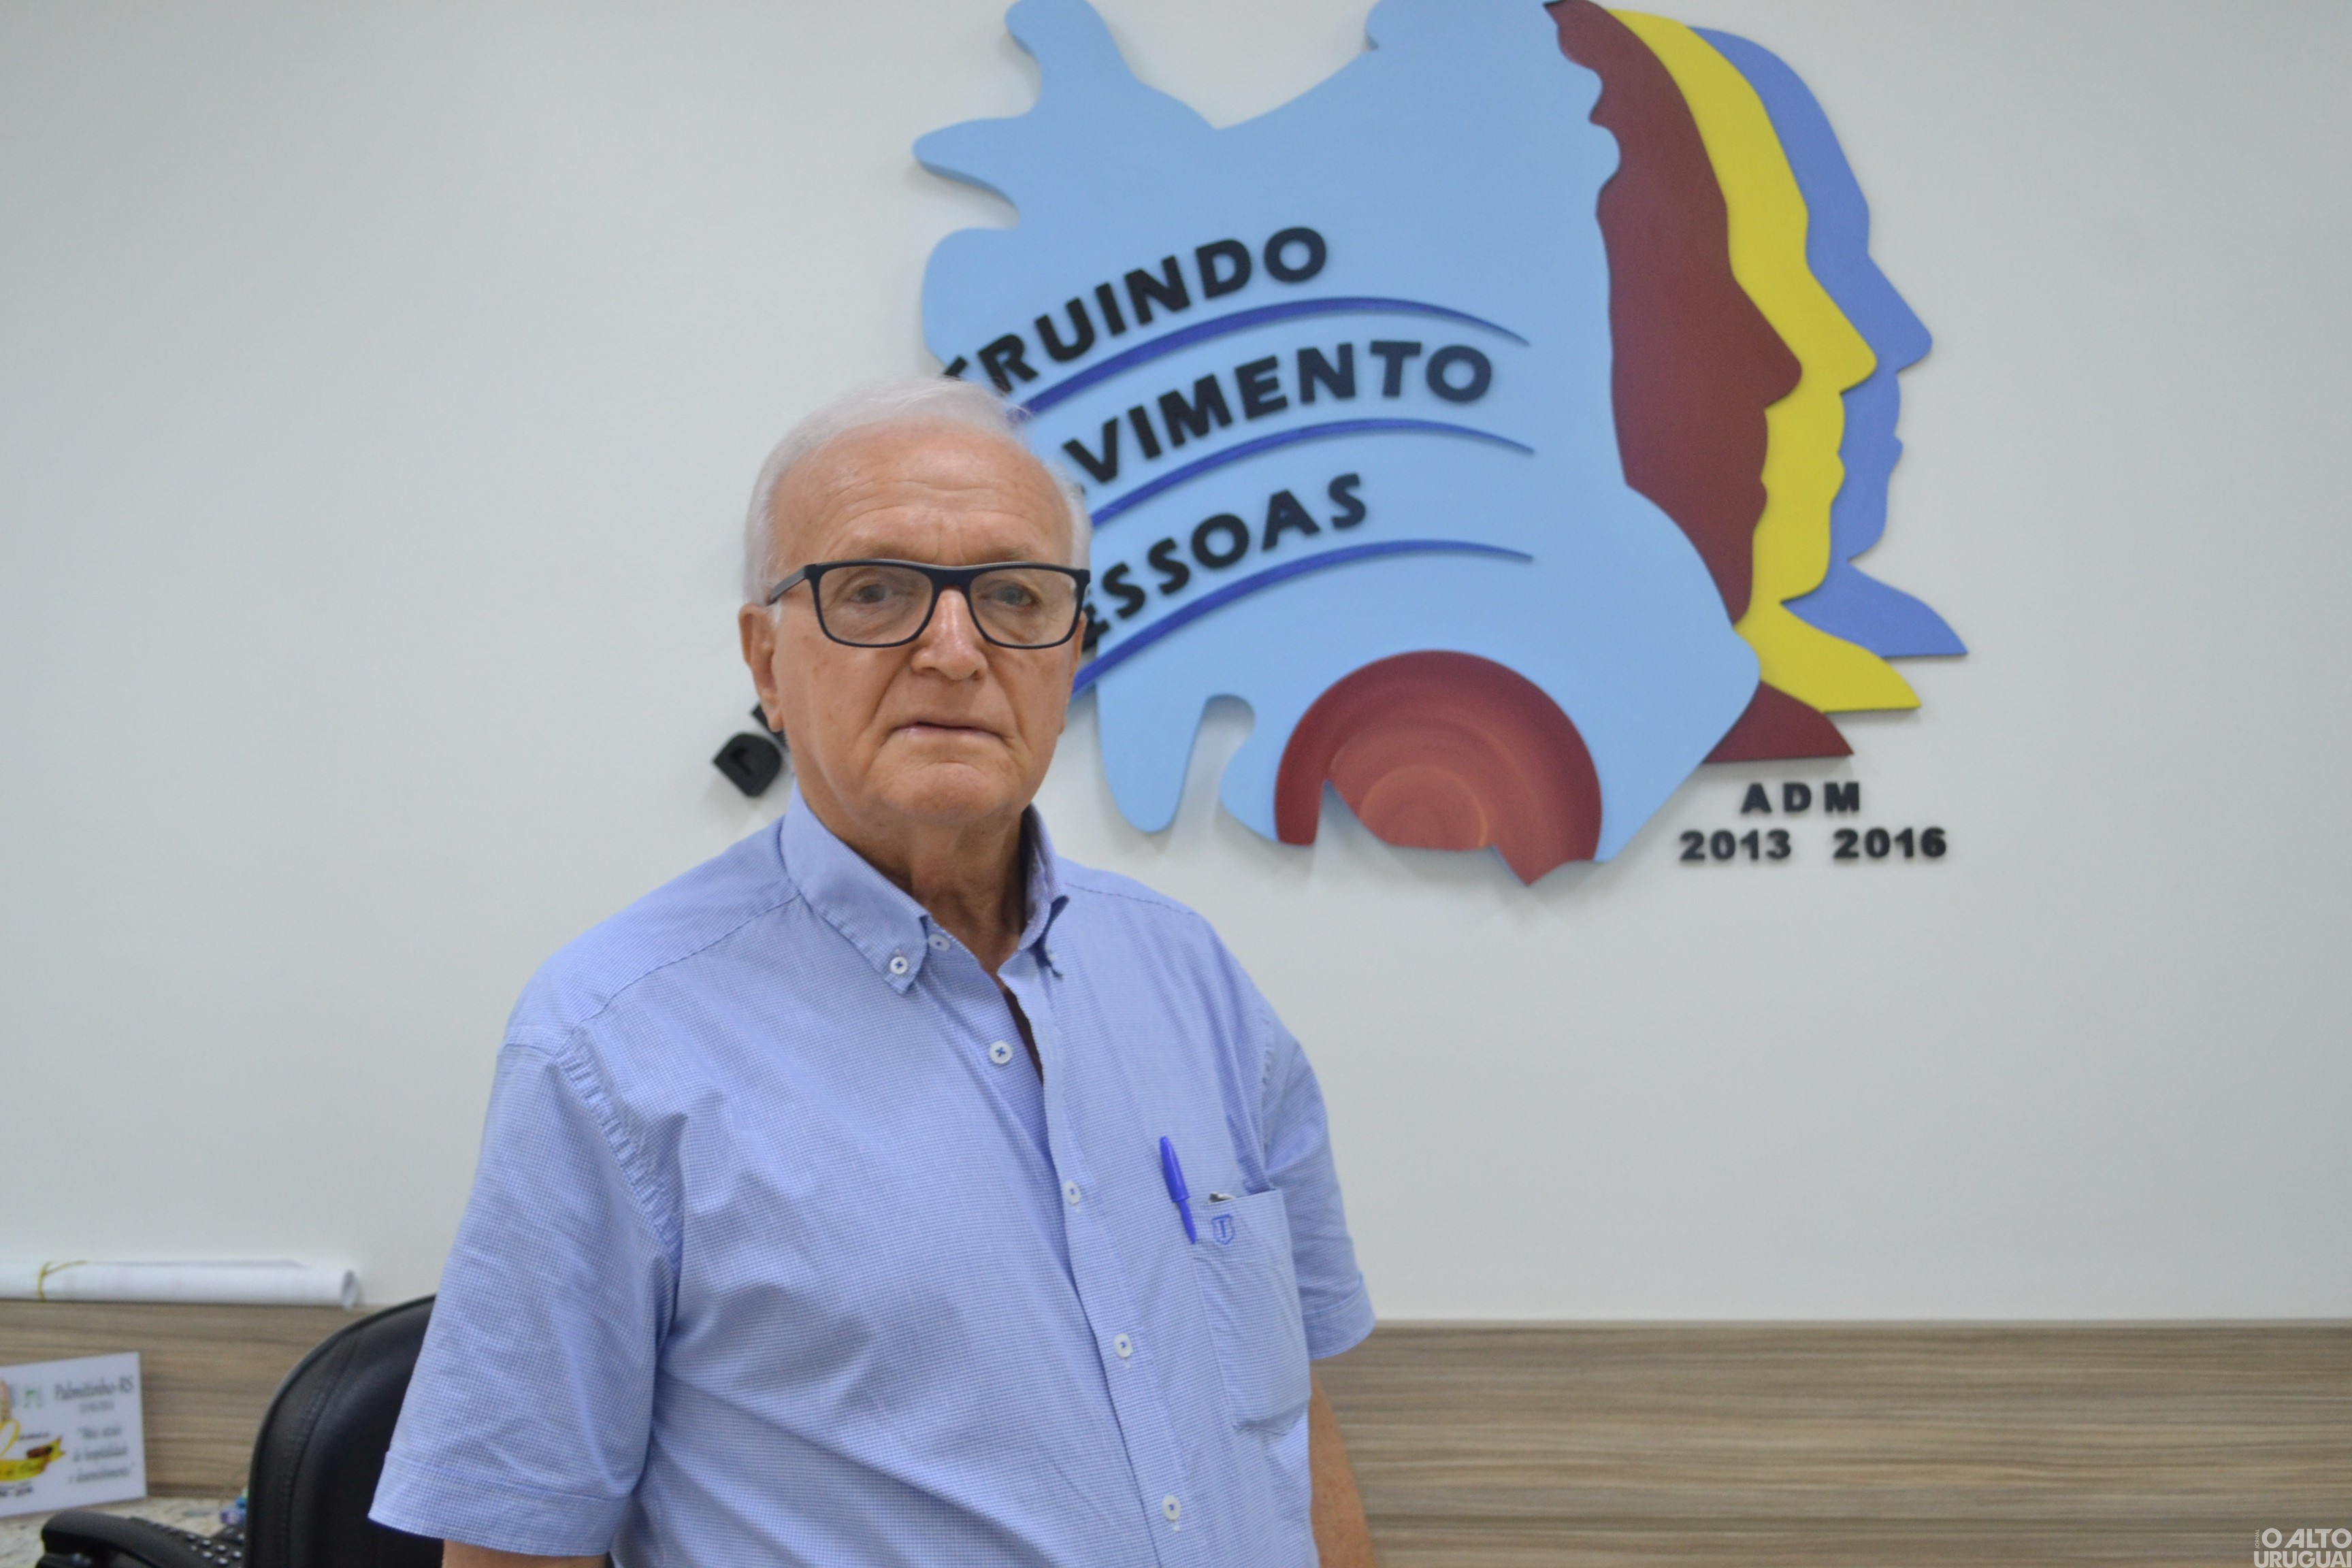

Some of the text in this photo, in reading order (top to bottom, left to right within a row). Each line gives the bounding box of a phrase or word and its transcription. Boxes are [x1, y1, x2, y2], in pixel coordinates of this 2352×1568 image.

[1062, 340, 1493, 494] VIMENTO
[1740, 781, 1861, 815] ADM
[1679, 826, 1948, 862] 2013 2016
